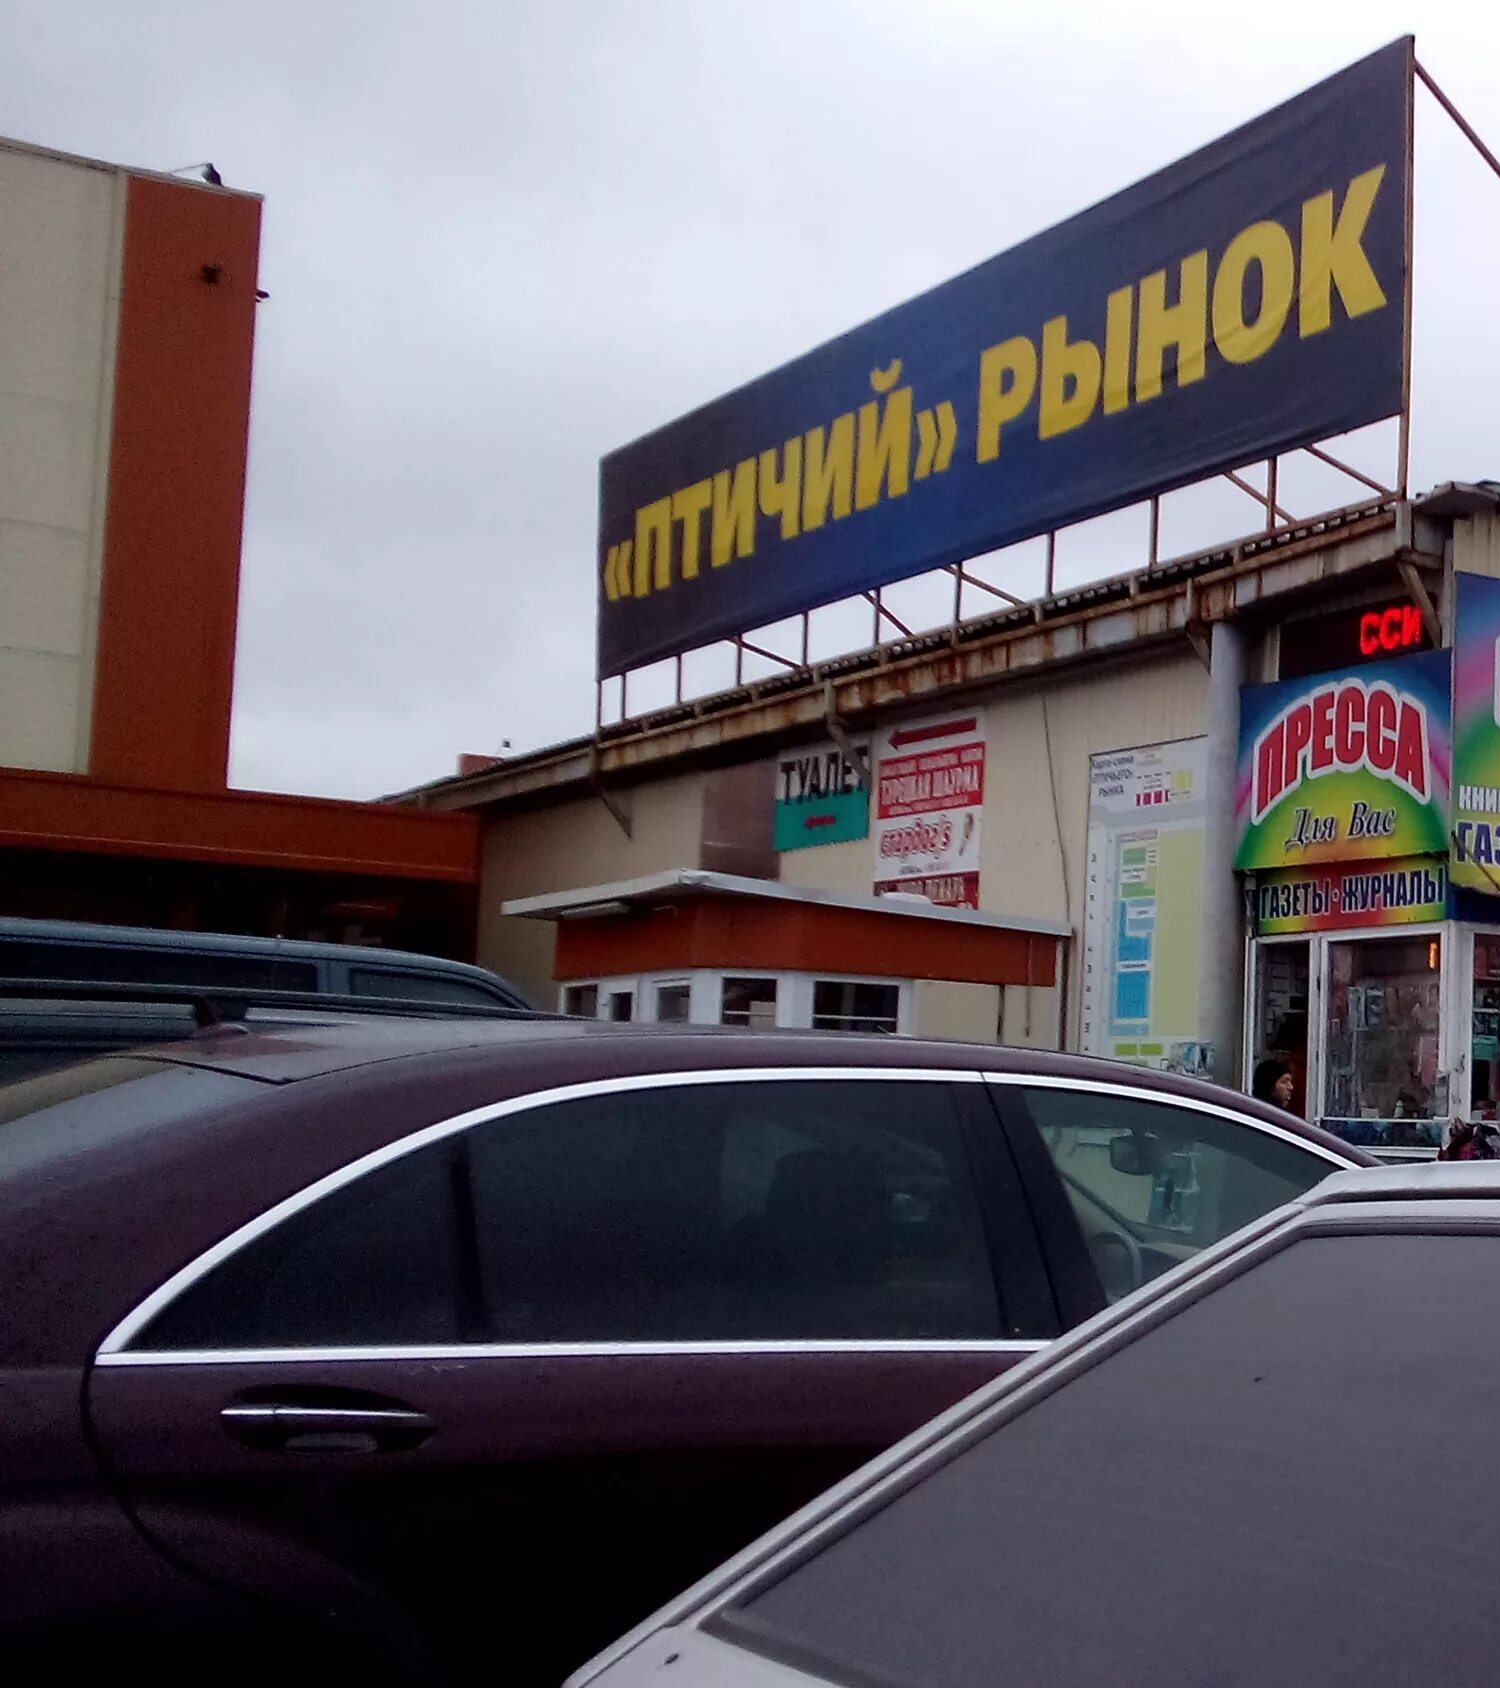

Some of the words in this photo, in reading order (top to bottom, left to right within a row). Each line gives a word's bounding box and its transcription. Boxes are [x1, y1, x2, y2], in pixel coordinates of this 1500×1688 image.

[604, 359, 957, 601] «ПТИЧИЙ»
[976, 163, 1387, 464] РЫНОК
[1254, 682, 1428, 817] ПРЕССА
[1286, 808, 1336, 850] Для
[1348, 802, 1396, 838] Вас
[1259, 880, 1329, 921] ГАЗЕТЫ
[1341, 866, 1445, 914] ЖУРНАЛЫ
